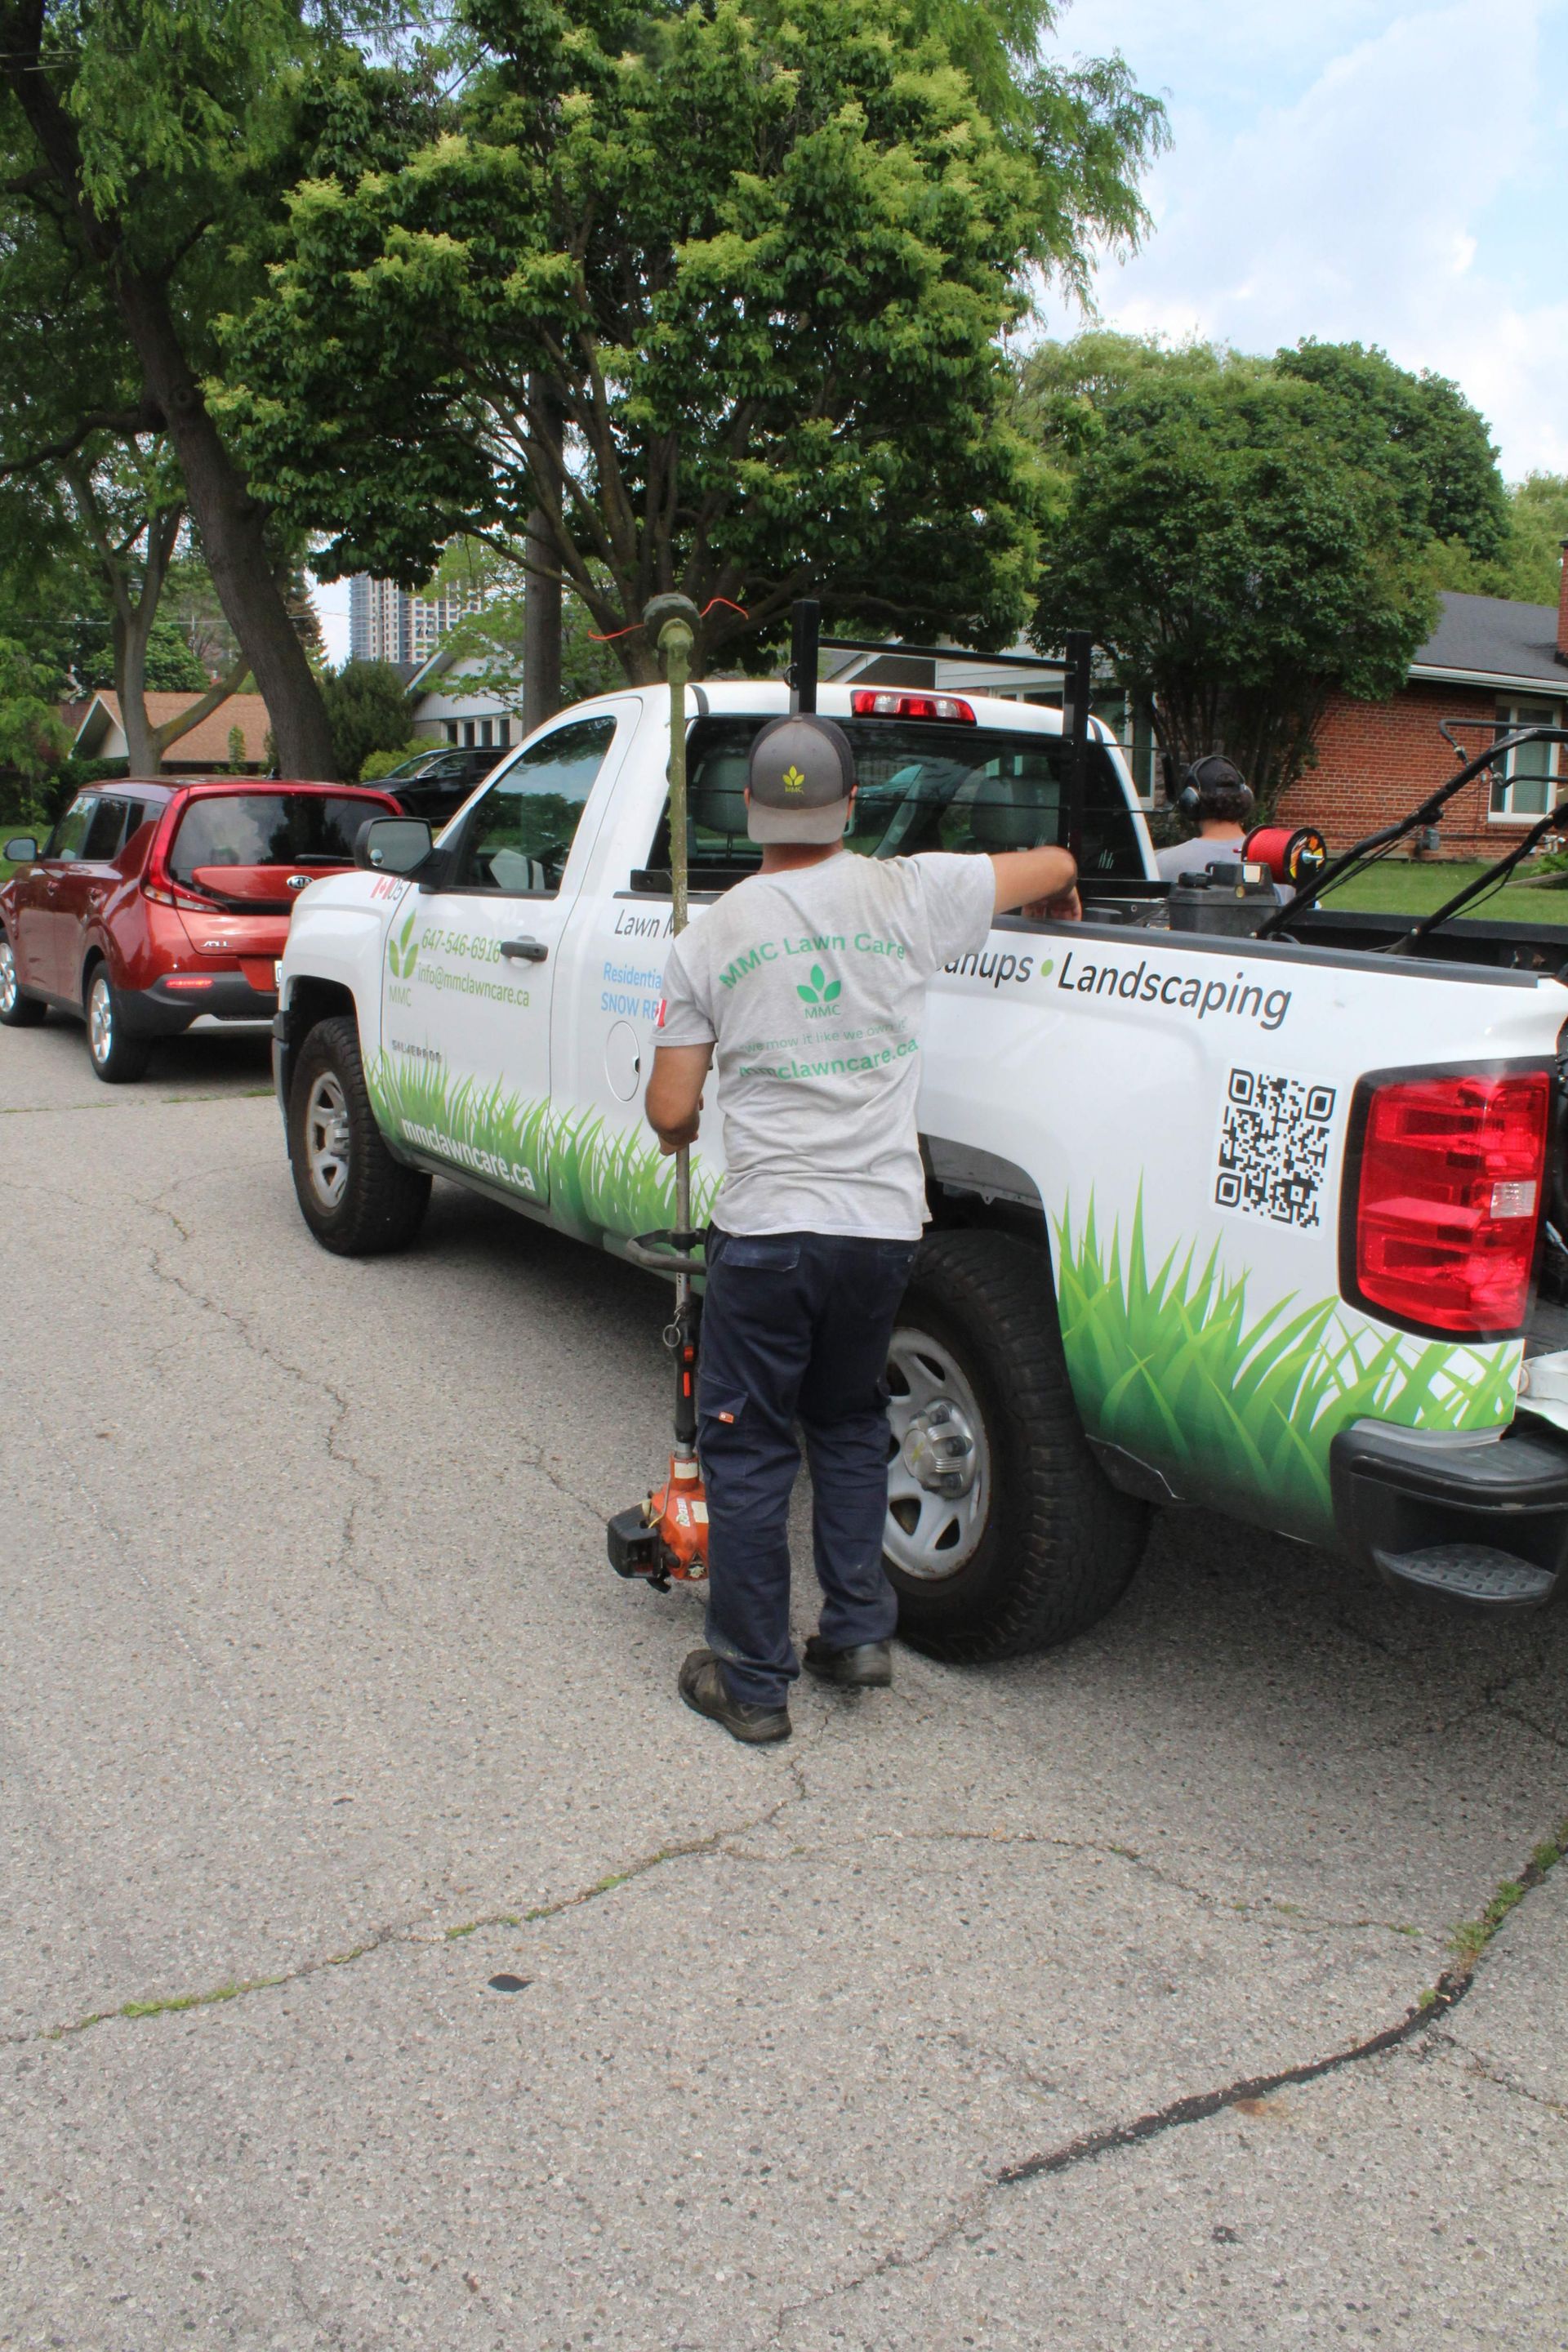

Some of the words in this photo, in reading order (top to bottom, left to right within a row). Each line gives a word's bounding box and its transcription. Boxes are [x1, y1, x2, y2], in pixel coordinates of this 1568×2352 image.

[614, 909, 660, 938] Lawn
[719, 942, 778, 989] MMC
[783, 935, 846, 956] Lawn
[854, 933, 906, 960] Care
[389, 984, 412, 1007] MMC
[417, 962, 529, 1007] info@mmclawncare.ca
[1058, 951, 1293, 1031] Landscaping
[601, 992, 639, 1017] SNOW
[804, 1004, 842, 1019] MMC
[766, 1037, 798, 1051] mow
[803, 1031, 814, 1045] it
[816, 1030, 840, 1044] like
[844, 1030, 863, 1040] we
[867, 1023, 894, 1036] own
[739, 1037, 919, 1080] mmclawncare.ca
[401, 1118, 536, 1192] mmclawncare.ca
